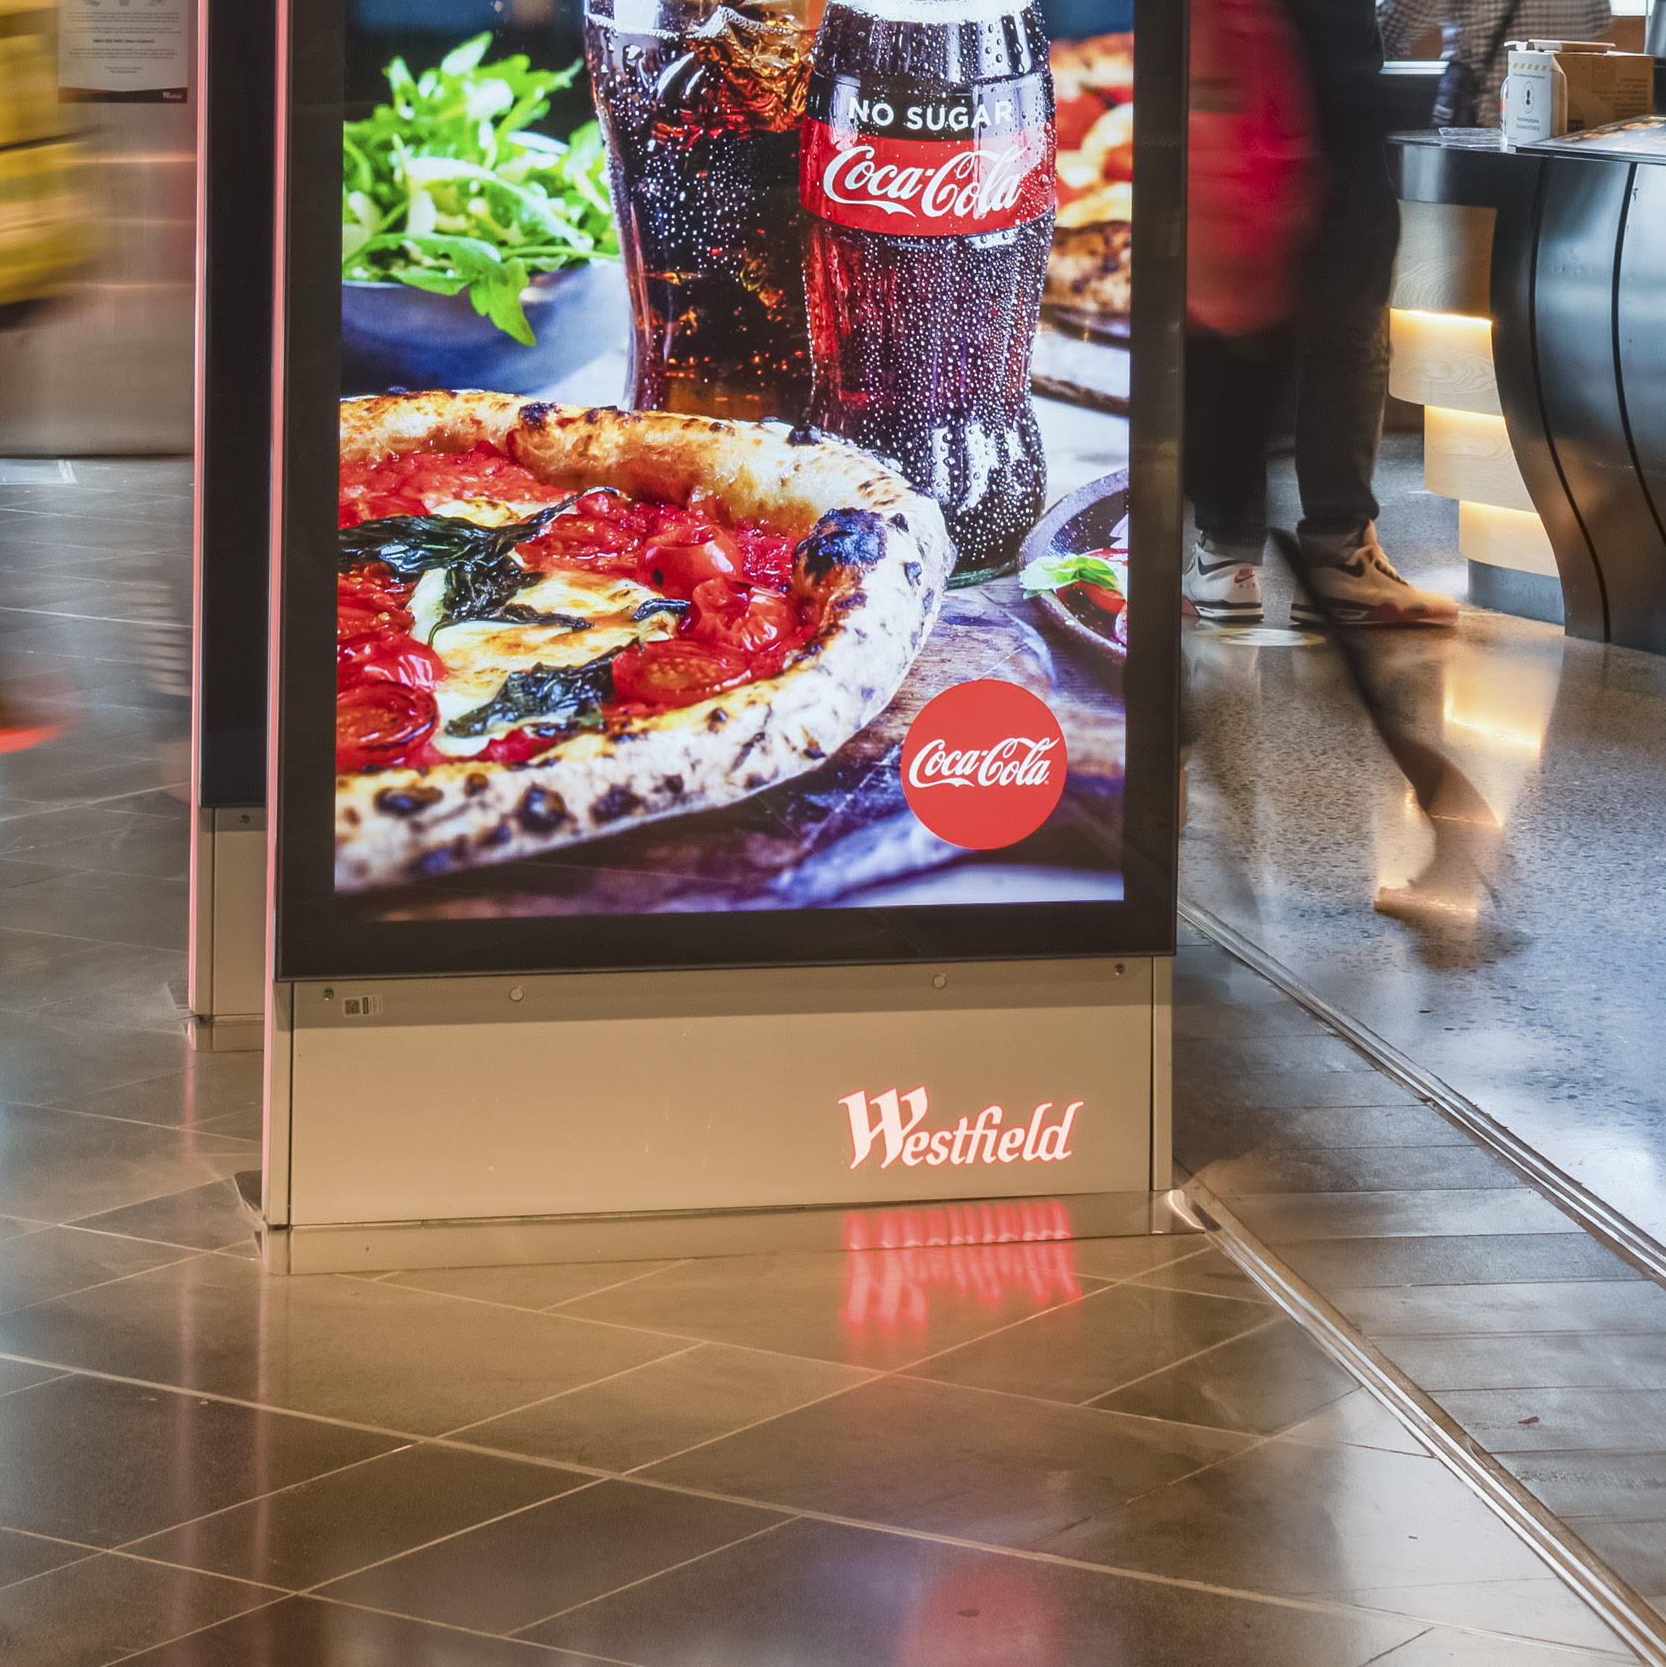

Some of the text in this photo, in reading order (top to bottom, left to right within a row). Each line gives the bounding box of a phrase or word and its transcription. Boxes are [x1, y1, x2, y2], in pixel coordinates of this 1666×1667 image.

[847, 97, 1014, 131] NO SUGAR
[822, 145, 1029, 221] Coca-Cola
[908, 737, 1060, 789] Coca-Cola
[837, 1085, 1085, 1170] Westfield
